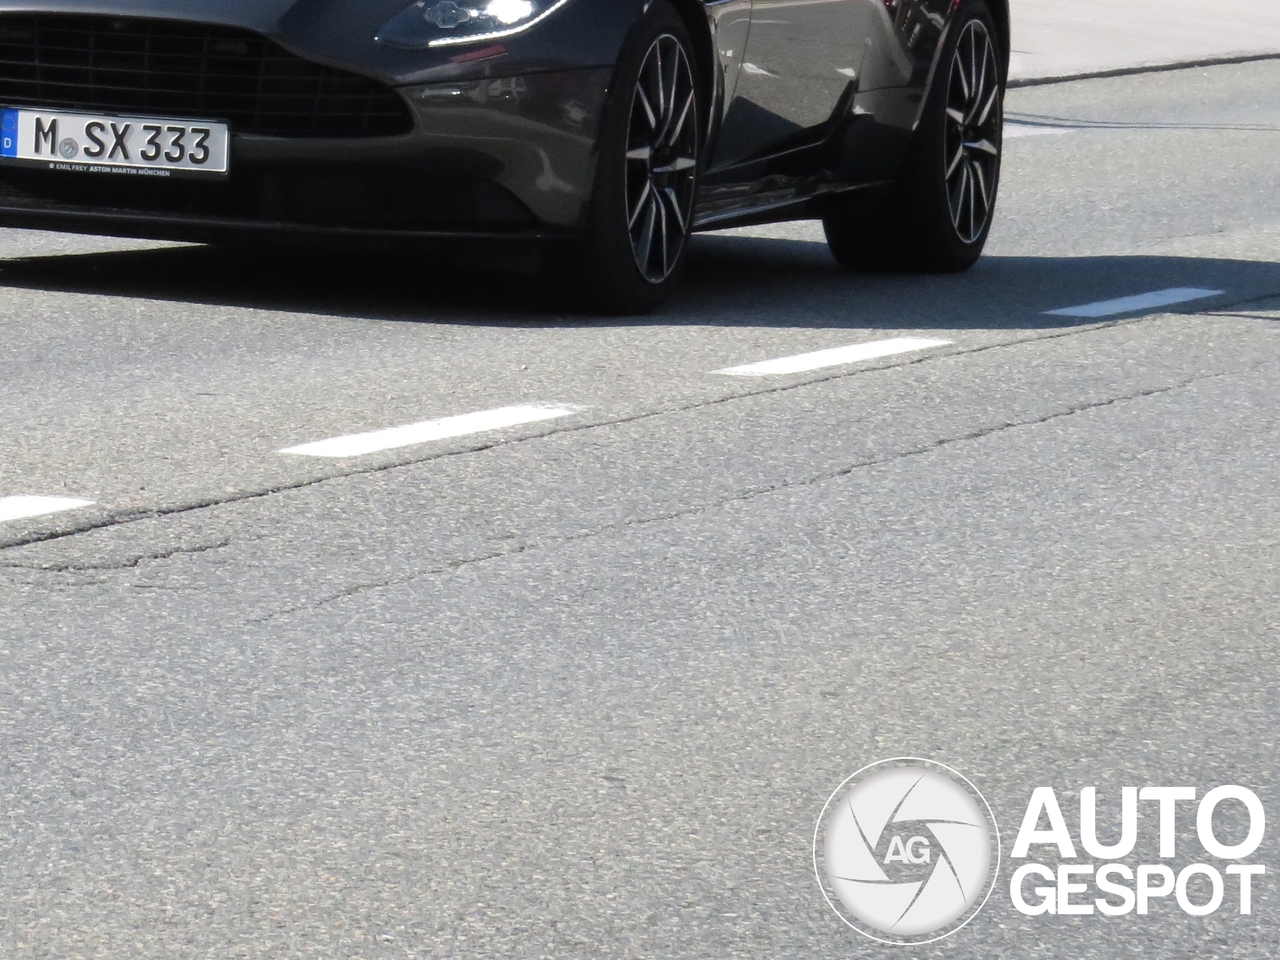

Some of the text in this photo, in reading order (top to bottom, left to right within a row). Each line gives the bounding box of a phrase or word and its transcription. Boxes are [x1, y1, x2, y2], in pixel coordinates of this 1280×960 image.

[3, 137, 12, 149] D
[34, 117, 58, 155] M
[140, 125, 211, 165] 333
[56, 163, 170, 177] EMIL FREY ASTON MARTIN MÜNCHEN
